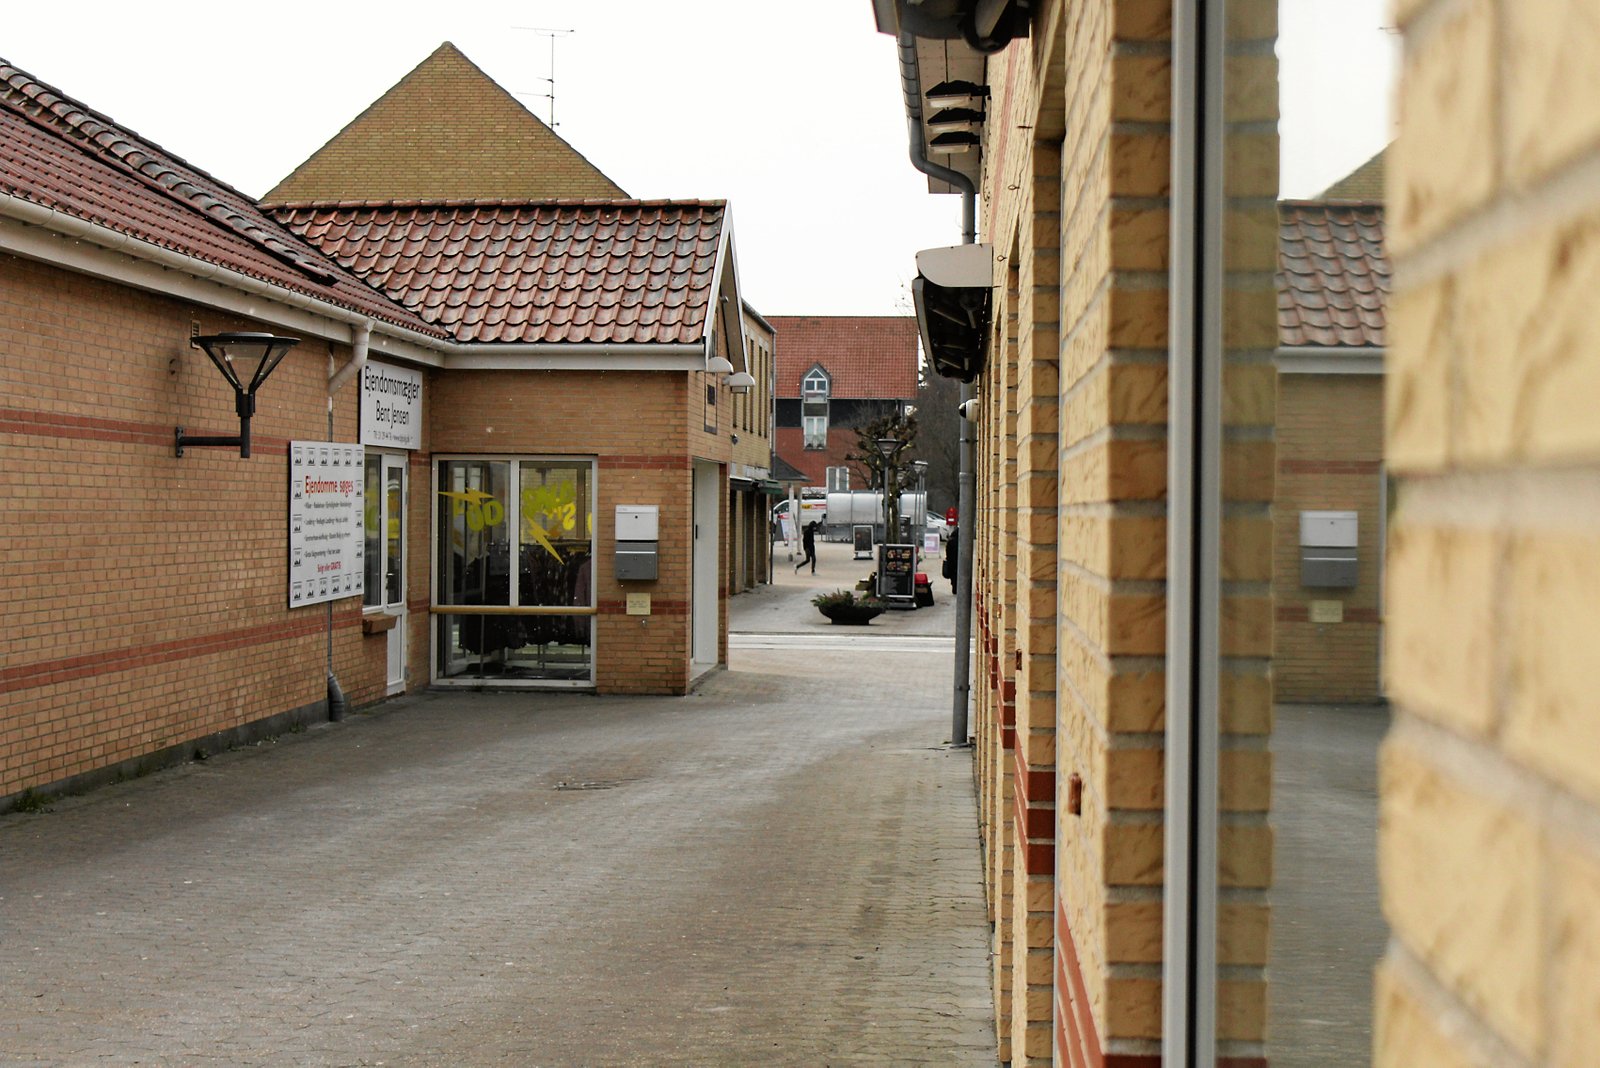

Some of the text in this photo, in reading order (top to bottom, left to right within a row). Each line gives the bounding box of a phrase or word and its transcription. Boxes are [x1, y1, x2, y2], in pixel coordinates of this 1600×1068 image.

[365, 365, 420, 405] Ejendomsmægler
[376, 400, 409, 429] Bent Jensen
[305, 475, 354, 499] Ejendomme søges
